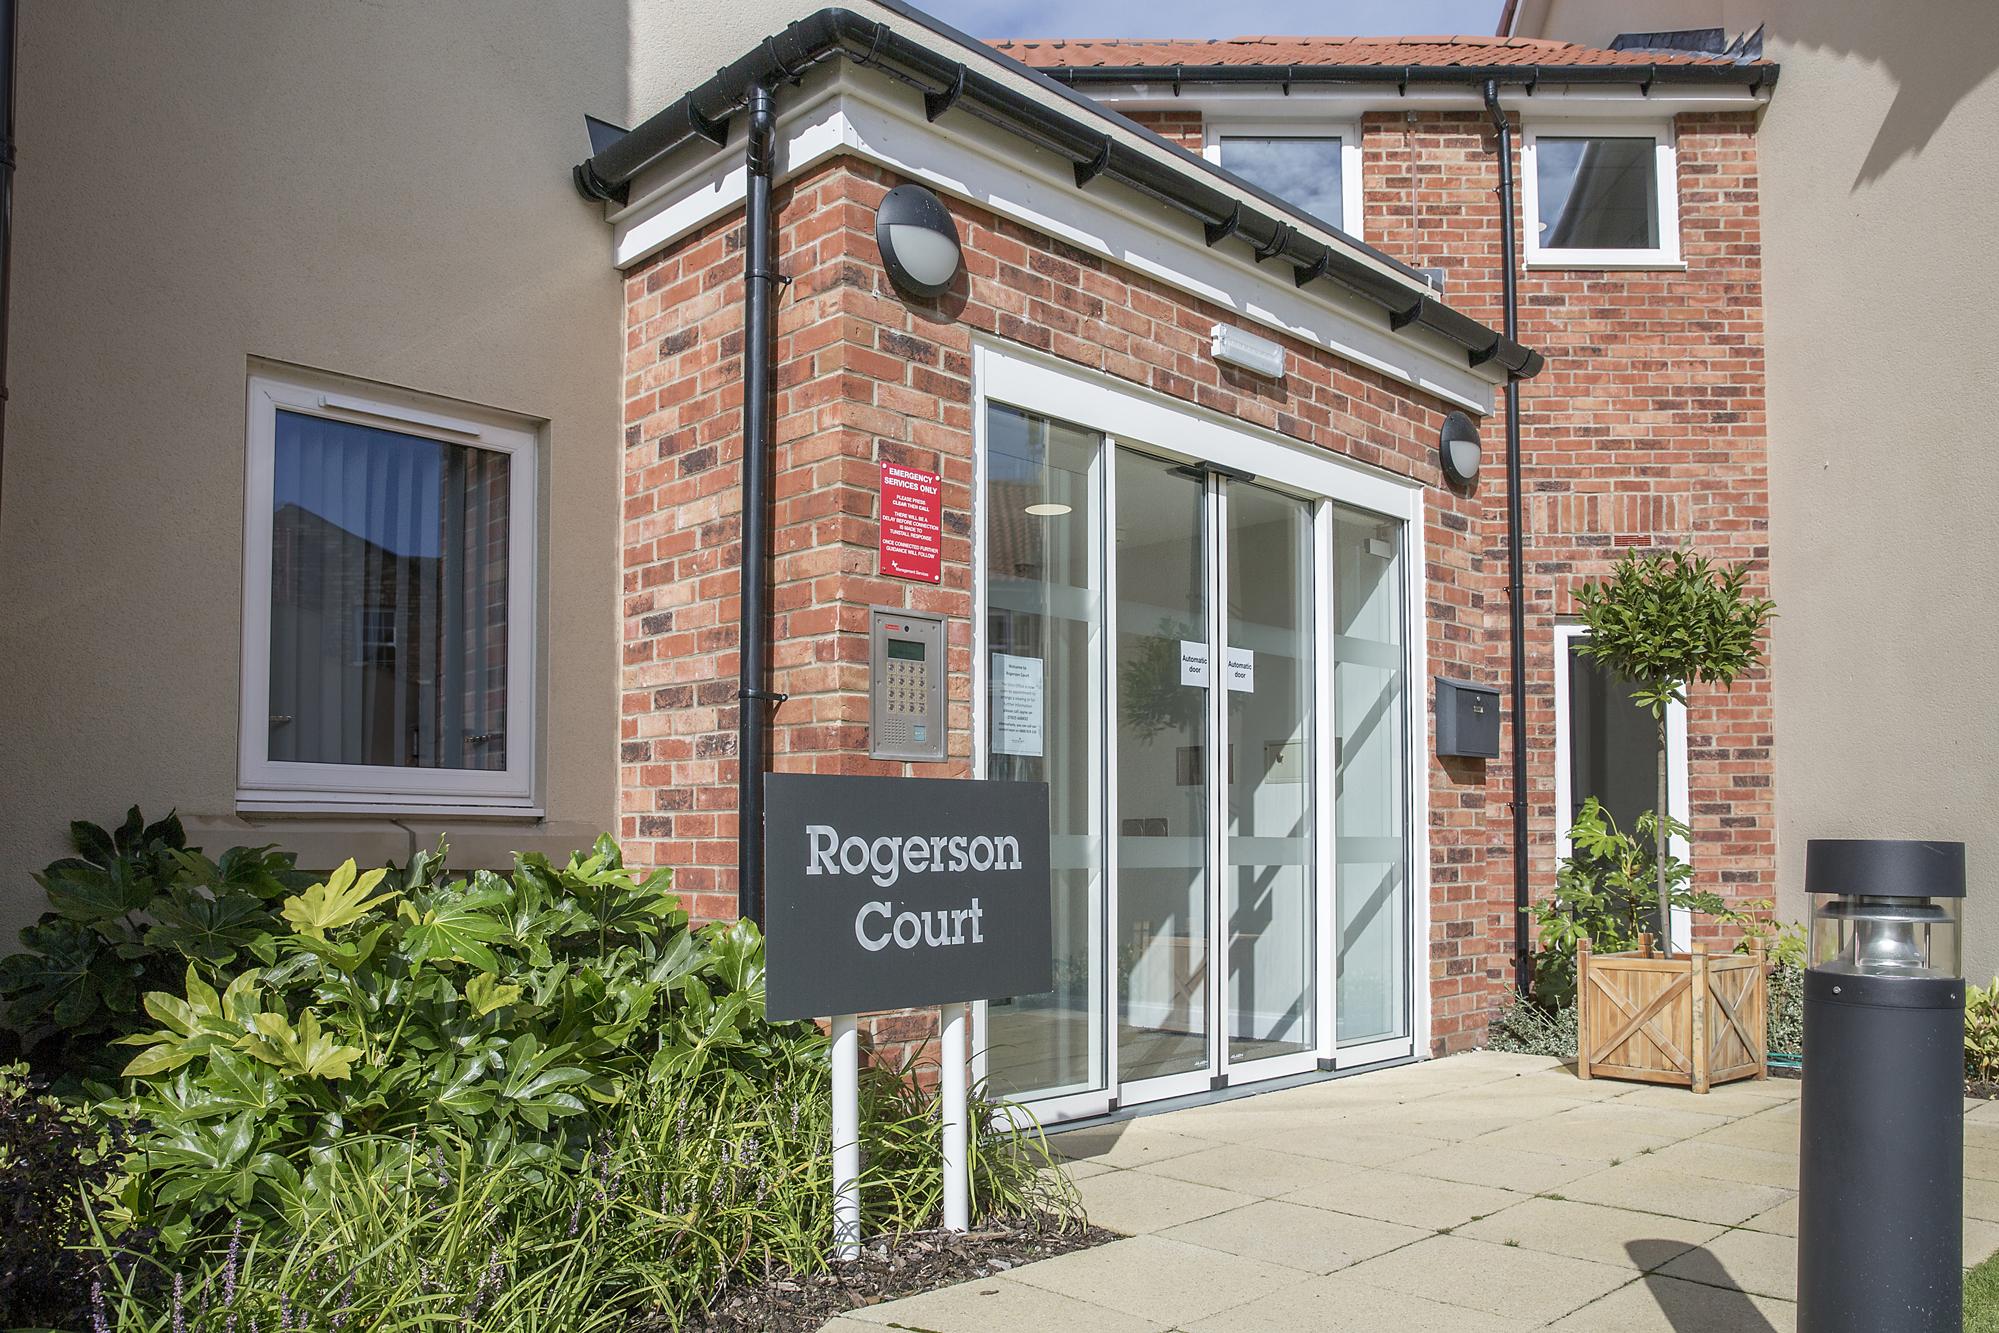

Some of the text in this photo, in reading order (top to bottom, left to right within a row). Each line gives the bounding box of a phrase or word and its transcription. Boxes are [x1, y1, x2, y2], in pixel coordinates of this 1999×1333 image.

[889, 468, 933, 484] EMERGENCY
[884, 477, 937, 495] SERVICES ONLY
[913, 521, 939, 531] CONNECTION
[911, 533, 932, 541] RESPONSE
[886, 545, 907, 554] GUIDANCE
[895, 541, 919, 550] CONNECTED
[896, 567, 915, 575] Management
[1182, 655, 1207, 664] Automatic
[1228, 661, 1252, 670] Automatic
[805, 824, 1023, 887] Rogerson
[855, 897, 984, 952] Court
